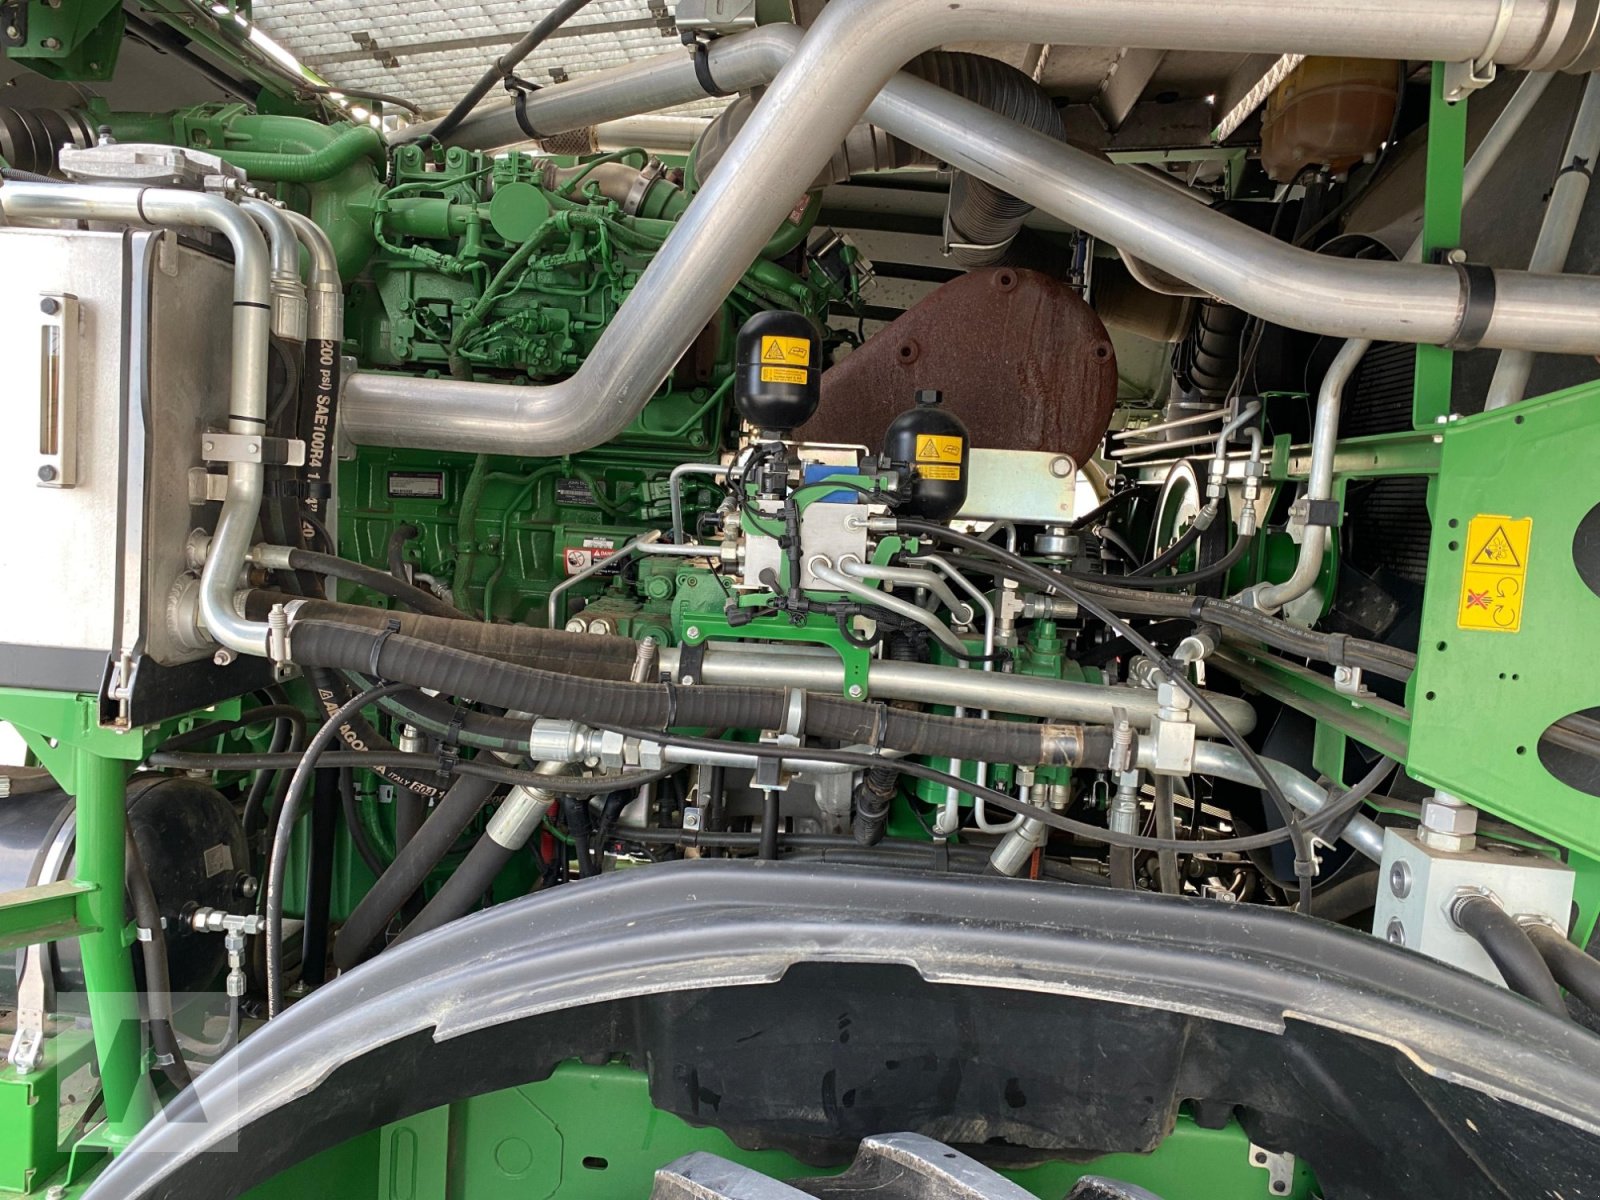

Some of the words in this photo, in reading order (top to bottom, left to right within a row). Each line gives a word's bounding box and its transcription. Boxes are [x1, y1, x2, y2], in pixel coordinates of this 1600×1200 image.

[308, 394, 331, 468] SAE100R4
[387, 771, 412, 786] ITALY
[411, 782, 436, 796] 604
